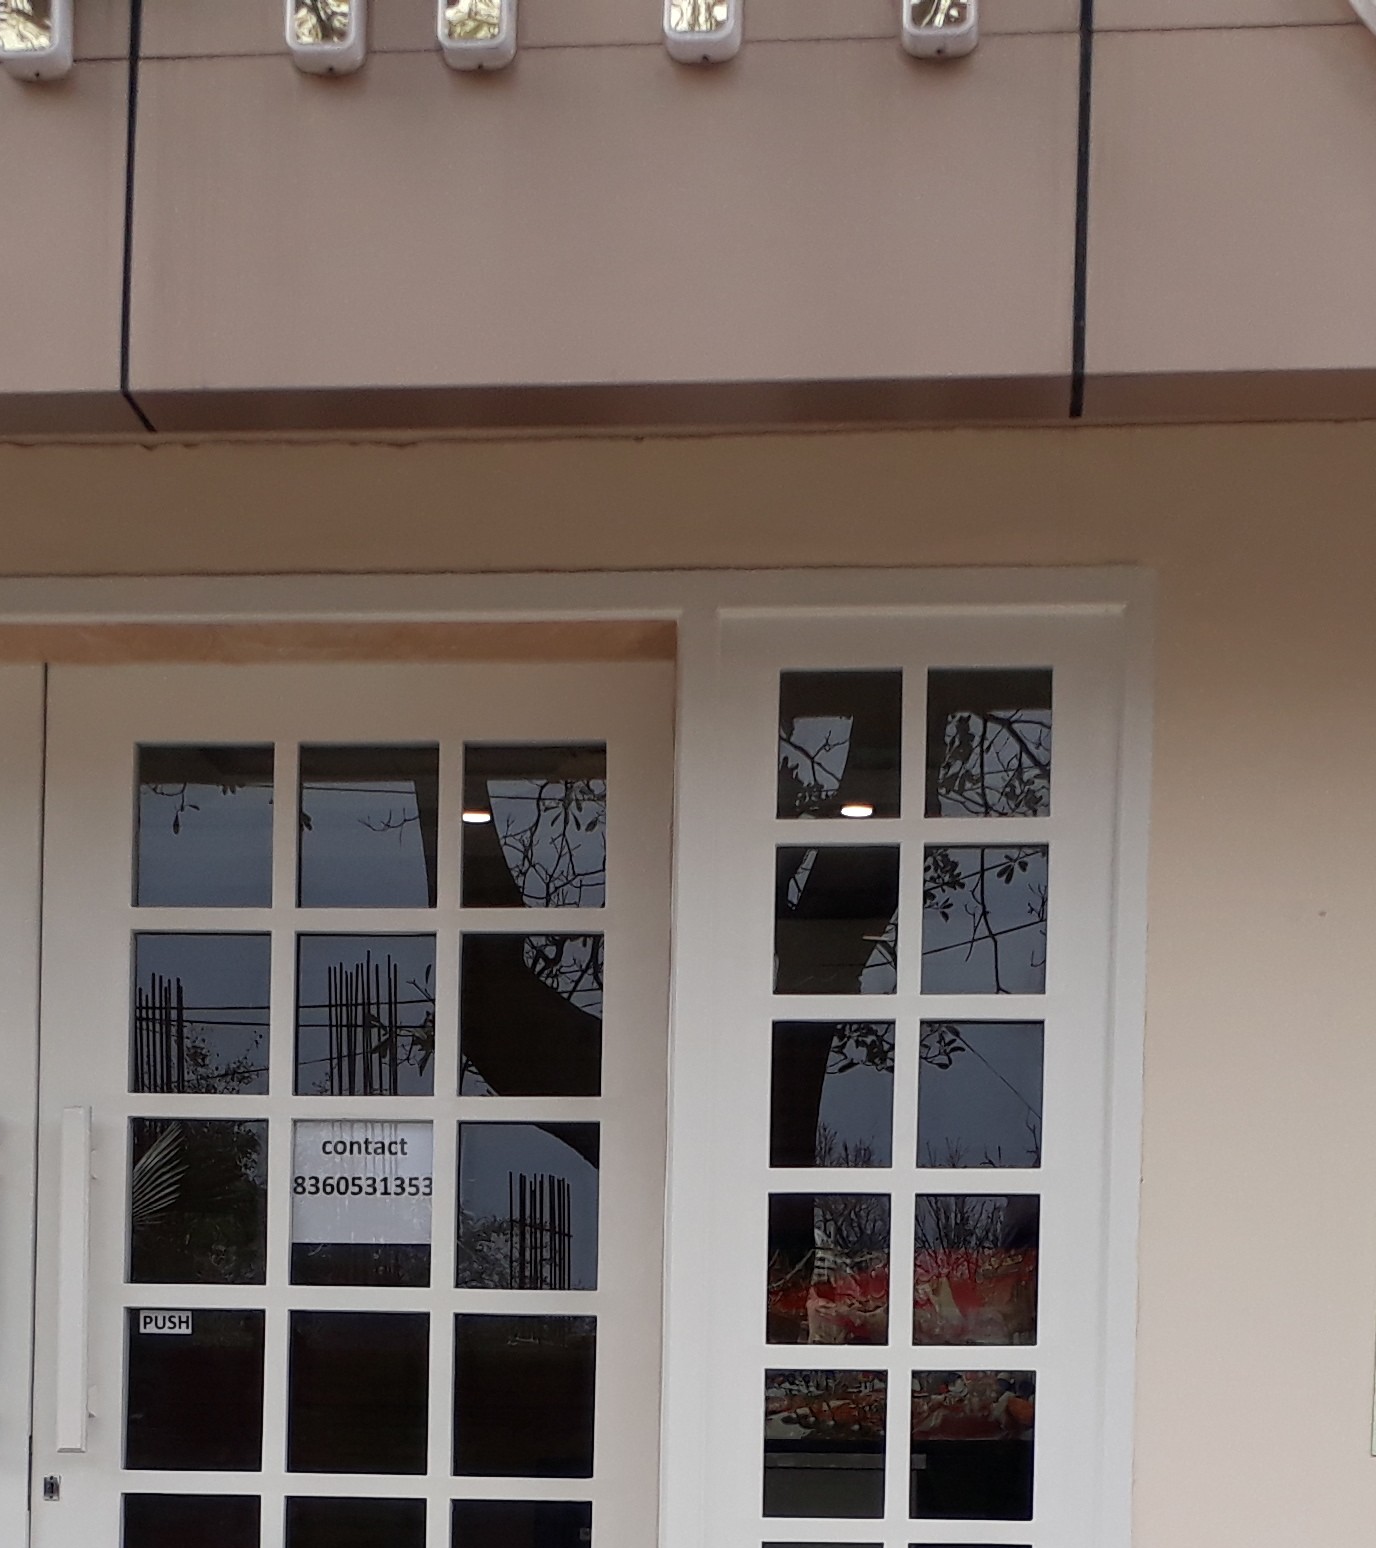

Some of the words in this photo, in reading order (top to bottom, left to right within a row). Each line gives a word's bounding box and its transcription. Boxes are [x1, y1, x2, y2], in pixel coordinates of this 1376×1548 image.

[321, 1137, 408, 1157] contact
[293, 1175, 432, 1198] 8360531353
[142, 1314, 191, 1331] PUSH
